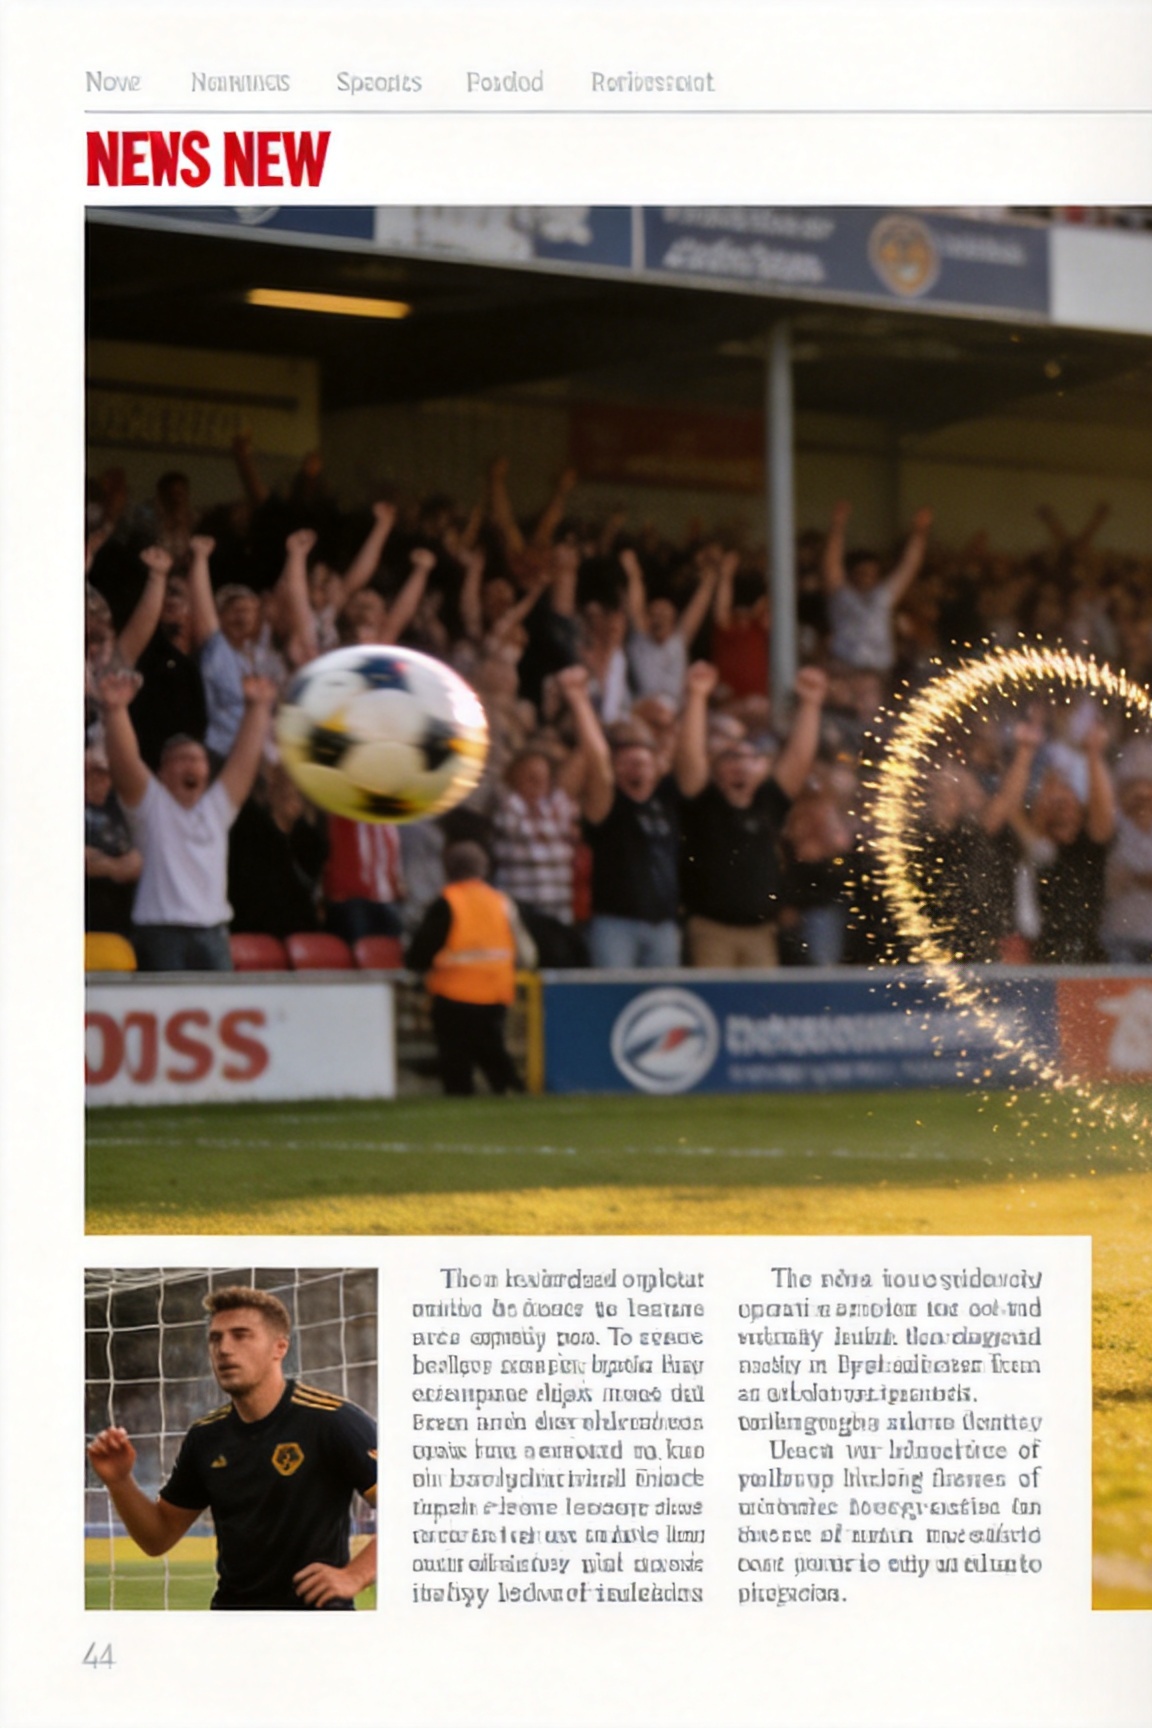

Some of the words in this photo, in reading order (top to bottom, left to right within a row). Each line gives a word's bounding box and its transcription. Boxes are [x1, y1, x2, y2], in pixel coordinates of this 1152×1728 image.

[223, 131, 332, 187] NEW
[607, 1327, 632, 1346] To
[1018, 1439, 1042, 1460] of
[1019, 1466, 1042, 1488] of
[81, 1641, 117, 1670] 44
